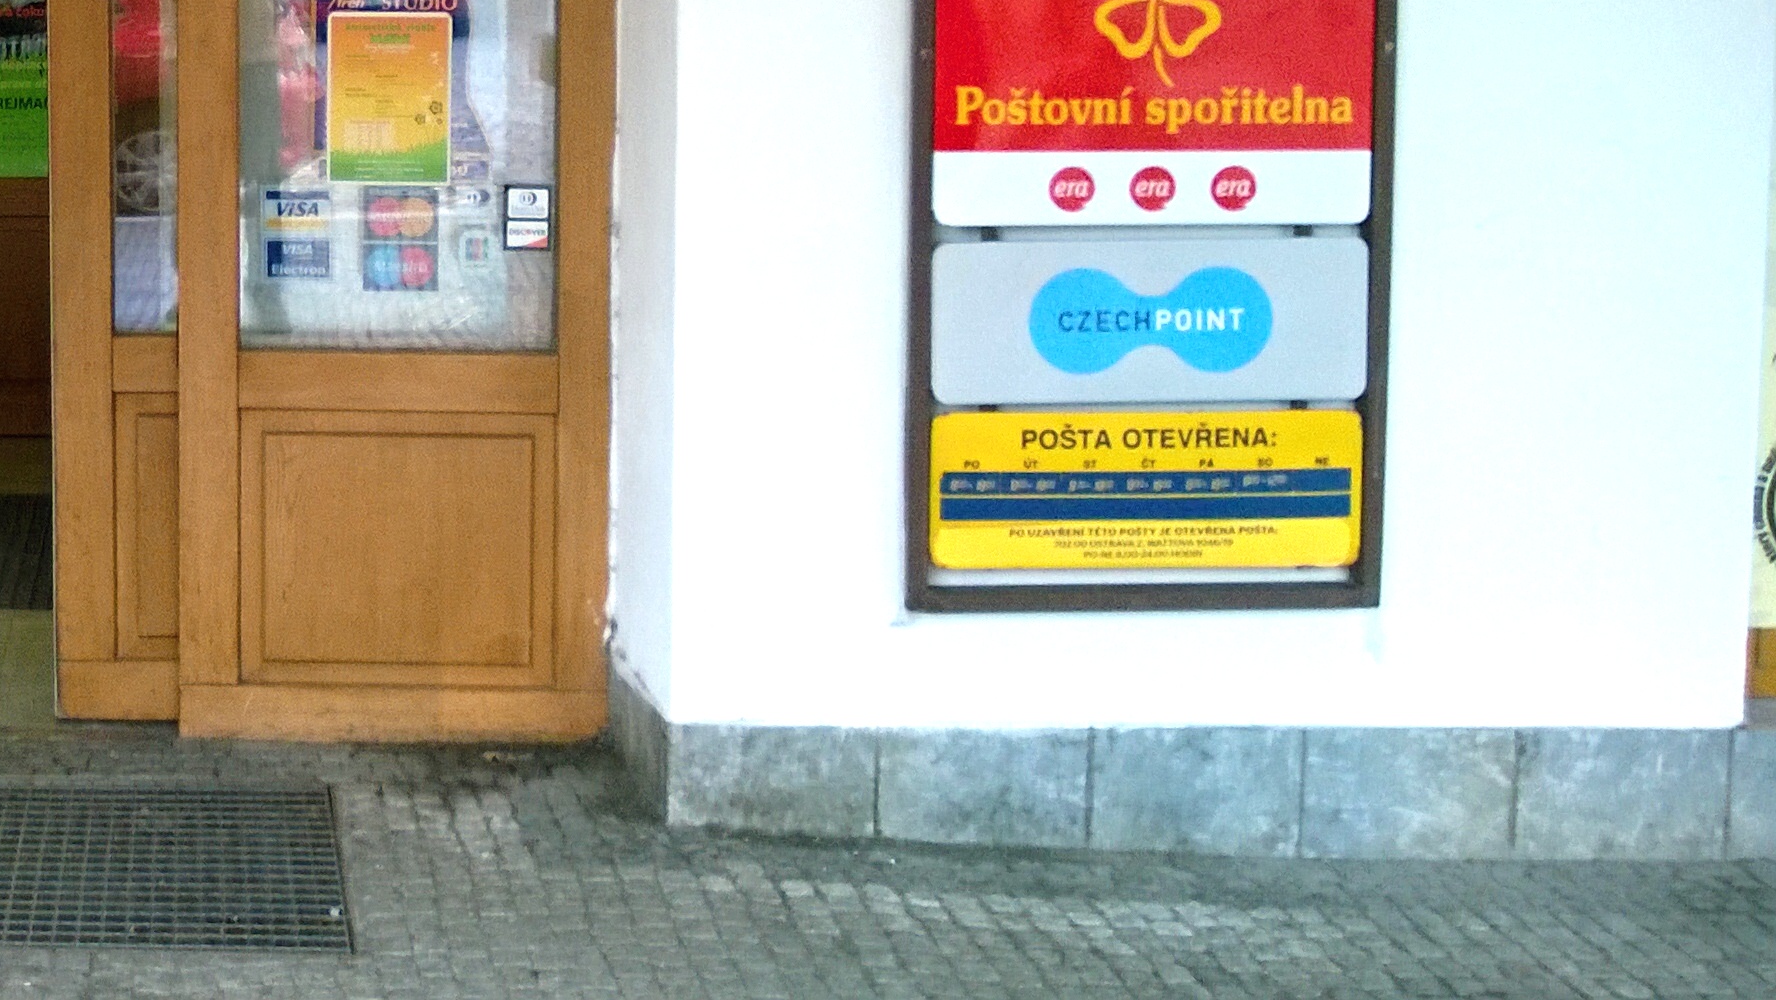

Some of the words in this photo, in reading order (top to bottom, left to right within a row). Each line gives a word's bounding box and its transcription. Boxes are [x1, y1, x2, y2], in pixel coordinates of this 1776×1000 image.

[955, 86, 1131, 126] Poštovní
[1144, 85, 1353, 134] spořitelna
[1055, 178, 1089, 198] era
[1135, 177, 1170, 198] era
[1215, 177, 1251, 198] era
[277, 201, 319, 217] VISA
[281, 244, 313, 255] VISA
[271, 263, 326, 275] Electron
[1022, 423, 1111, 450] POŠTA
[1123, 422, 1277, 449] OTEVŘENA:
